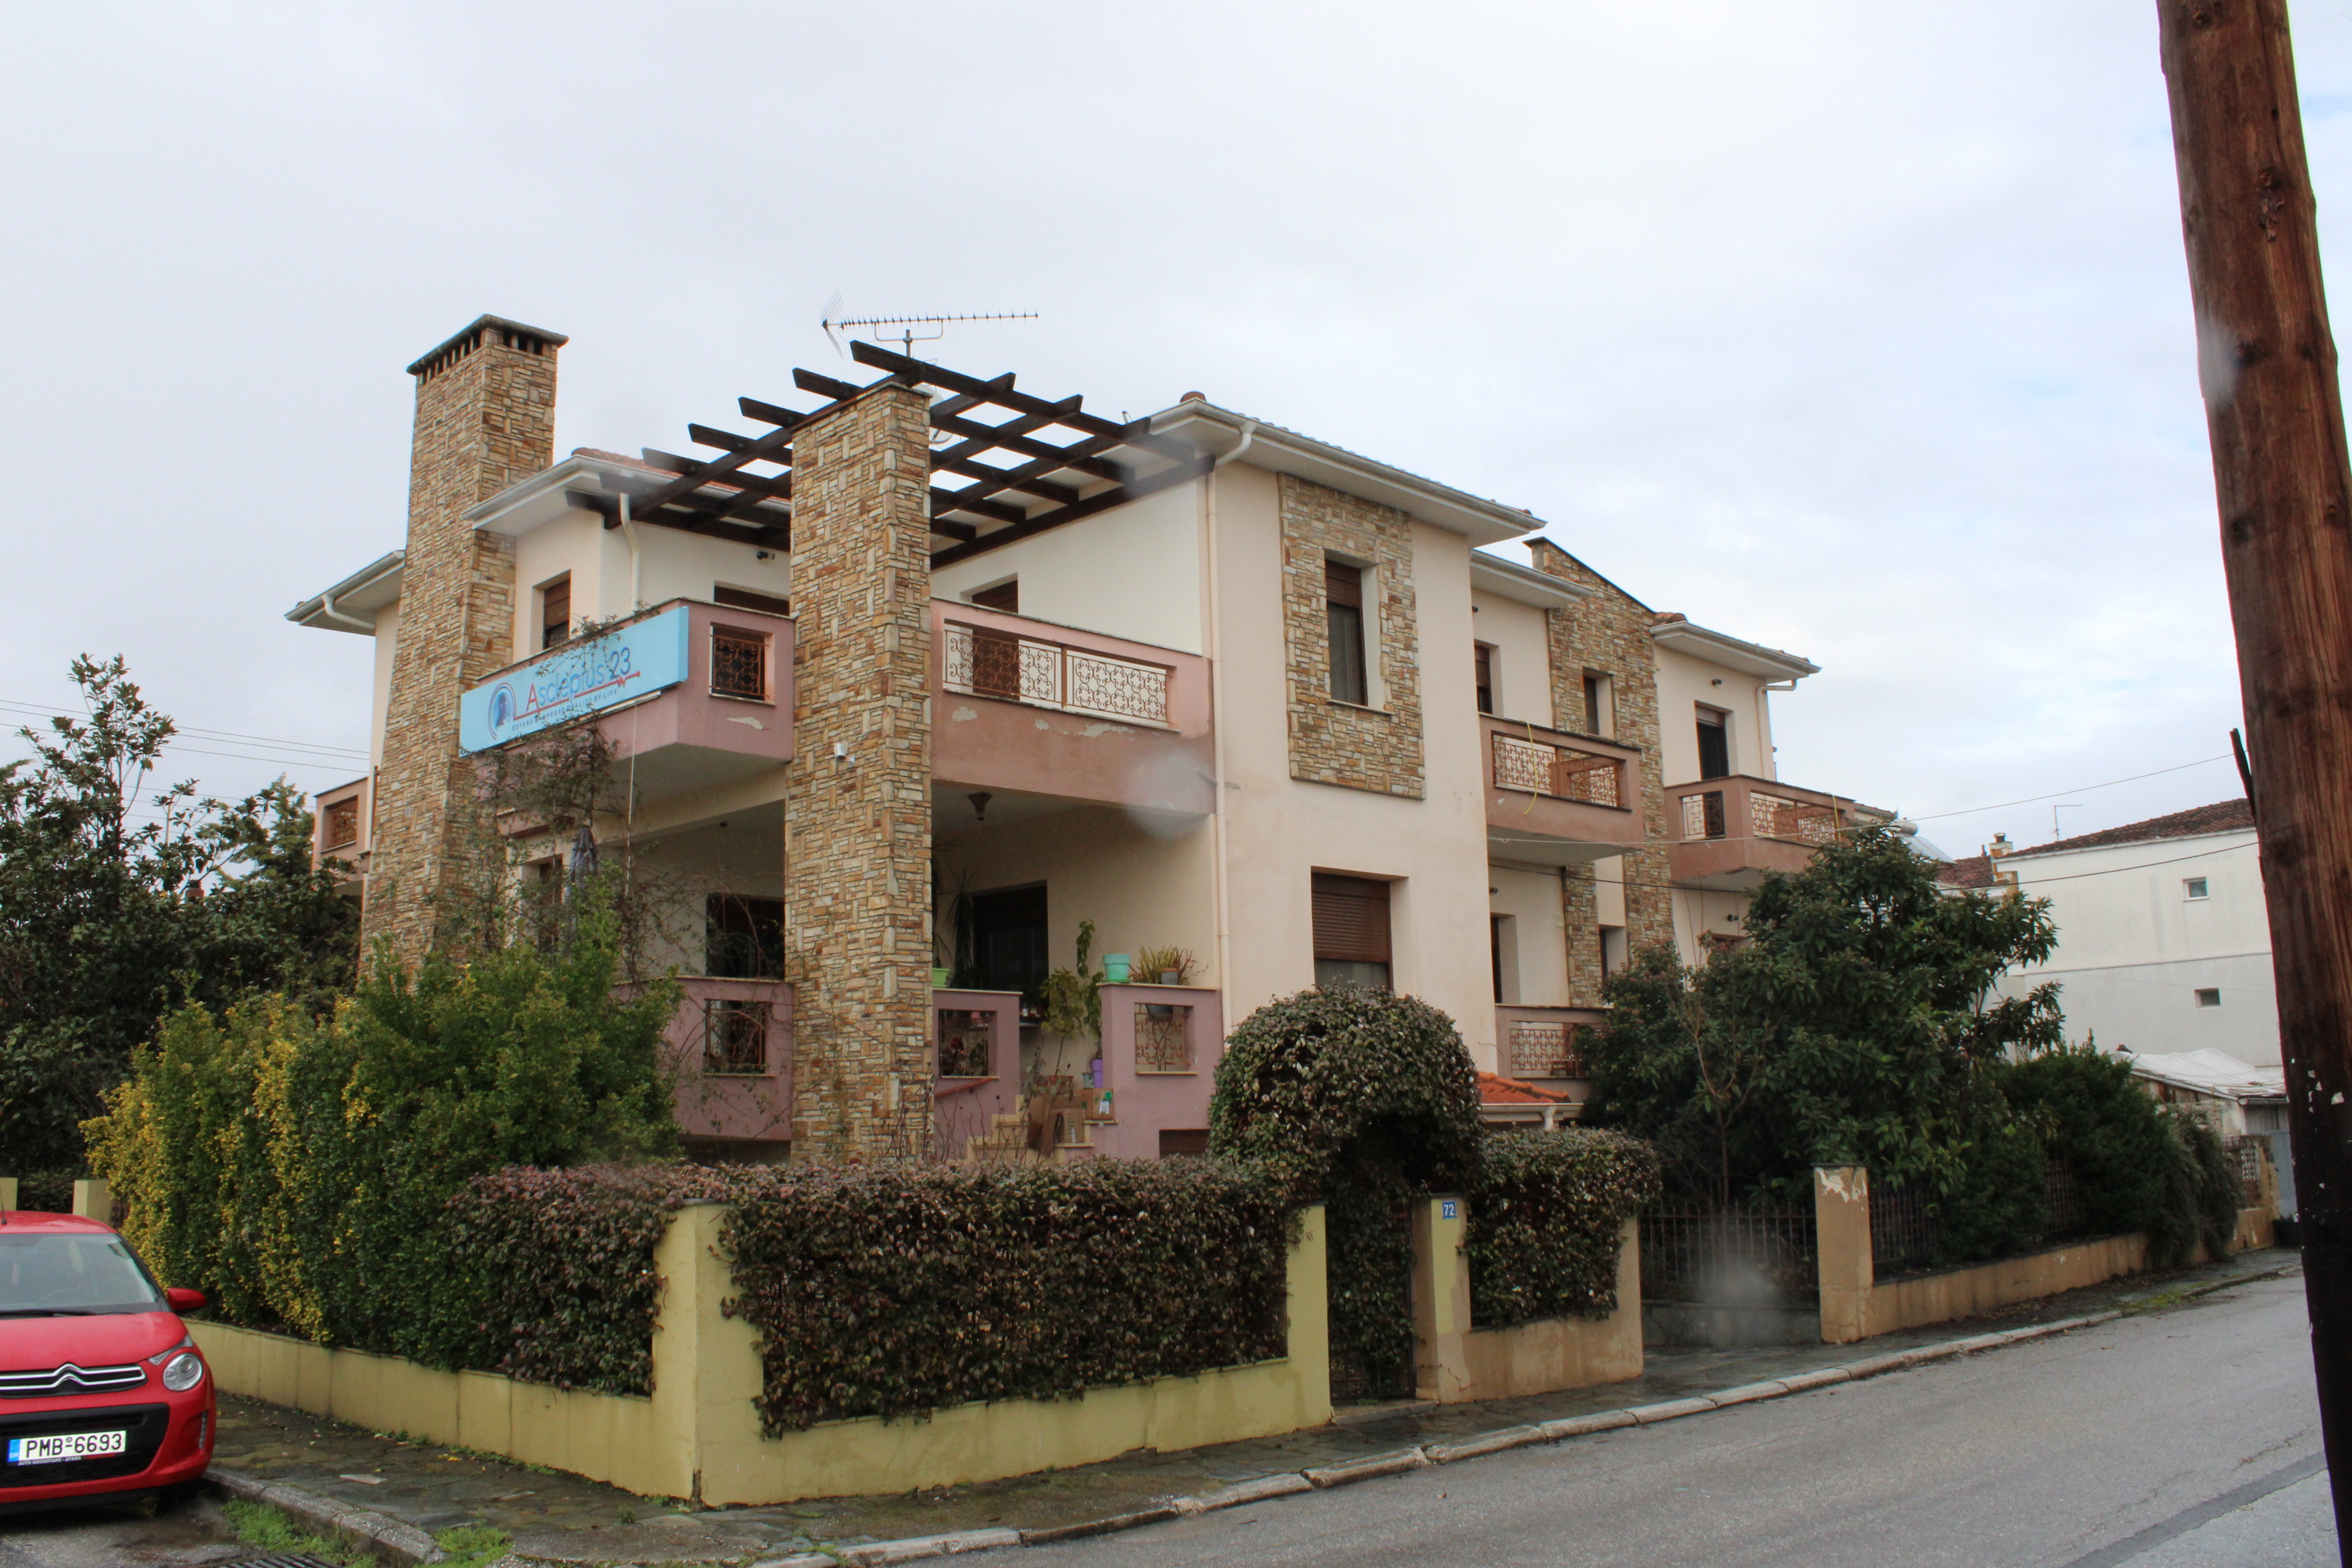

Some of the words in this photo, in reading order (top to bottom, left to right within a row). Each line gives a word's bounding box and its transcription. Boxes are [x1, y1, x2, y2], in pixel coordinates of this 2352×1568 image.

[526, 664, 605, 716] Asclepius
[610, 646, 631, 680] 23
[605, 688, 617, 699] LIFE
[1444, 1204, 1454, 1216] 72
